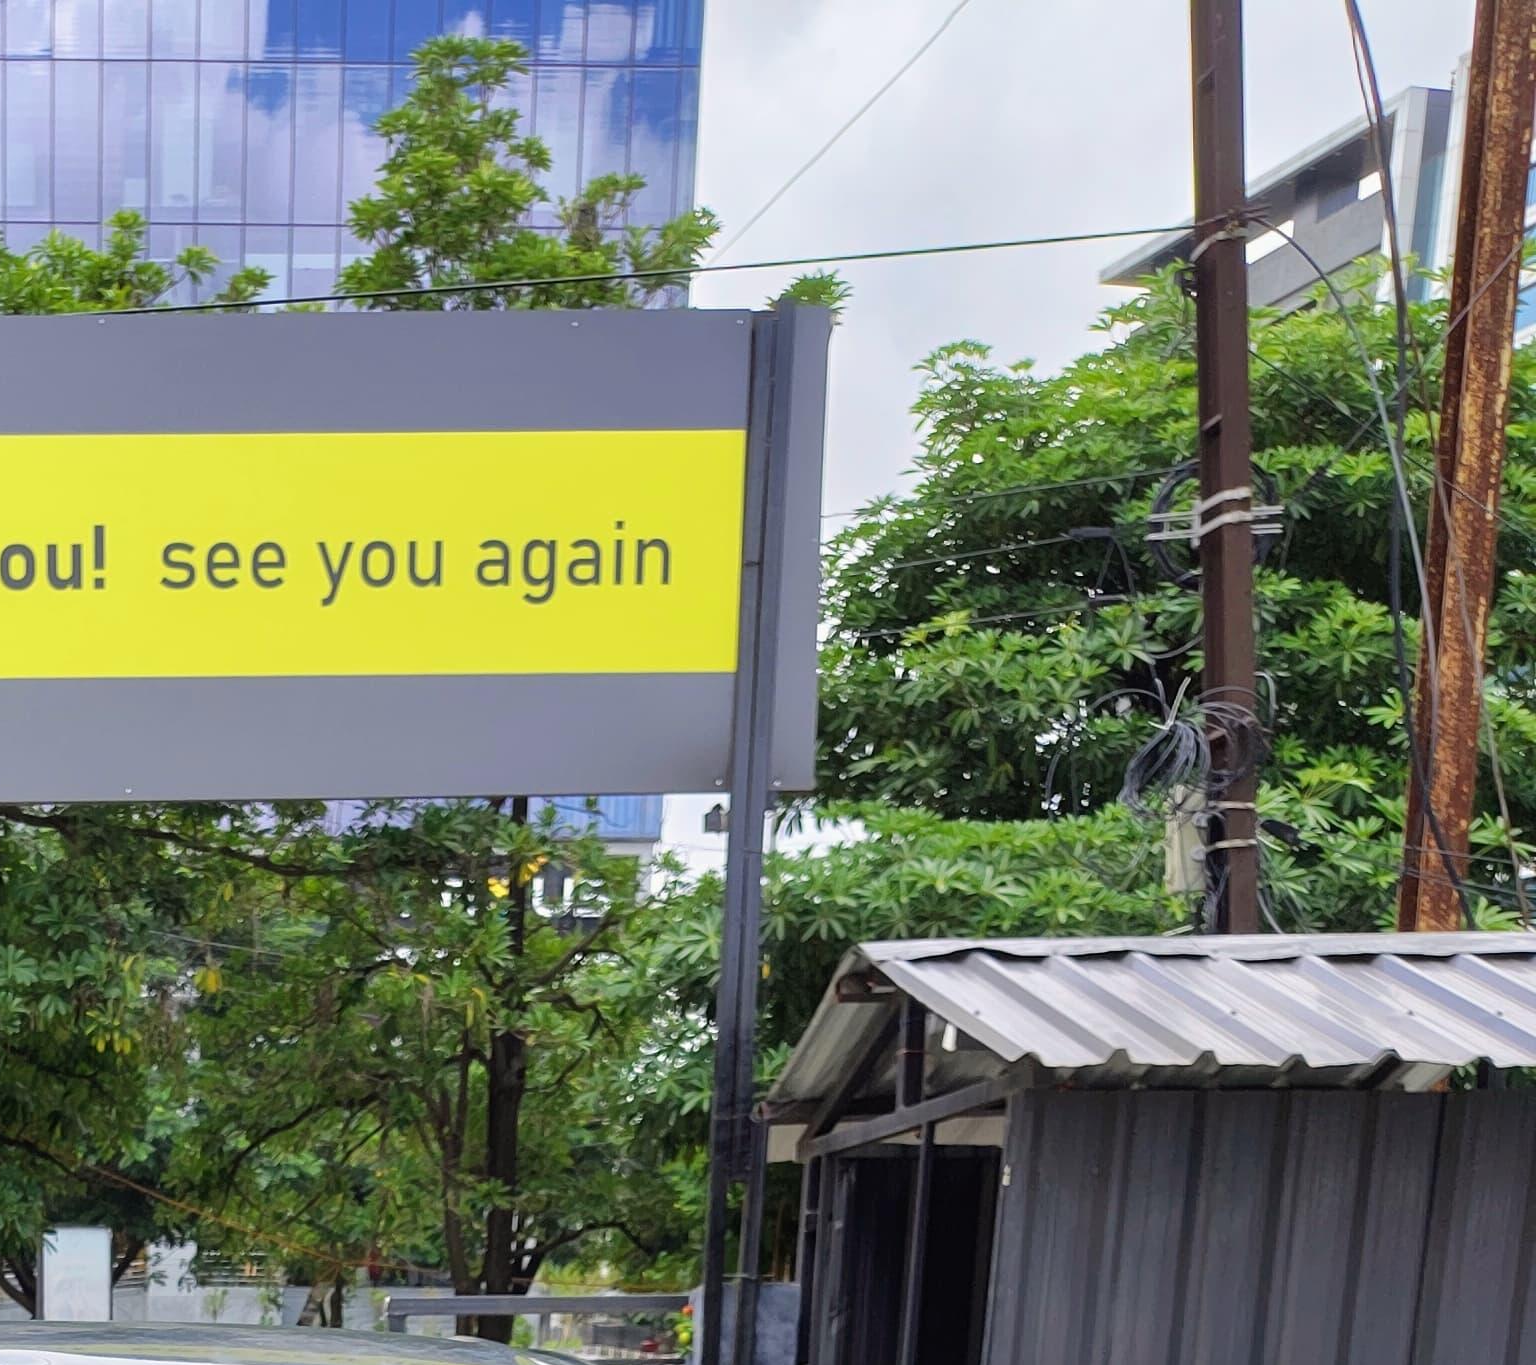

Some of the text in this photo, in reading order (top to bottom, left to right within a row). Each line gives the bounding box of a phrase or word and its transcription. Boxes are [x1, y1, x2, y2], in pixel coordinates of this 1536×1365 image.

[161, 542, 287, 591] see
[318, 541, 444, 608] you
[477, 521, 671, 606] again
